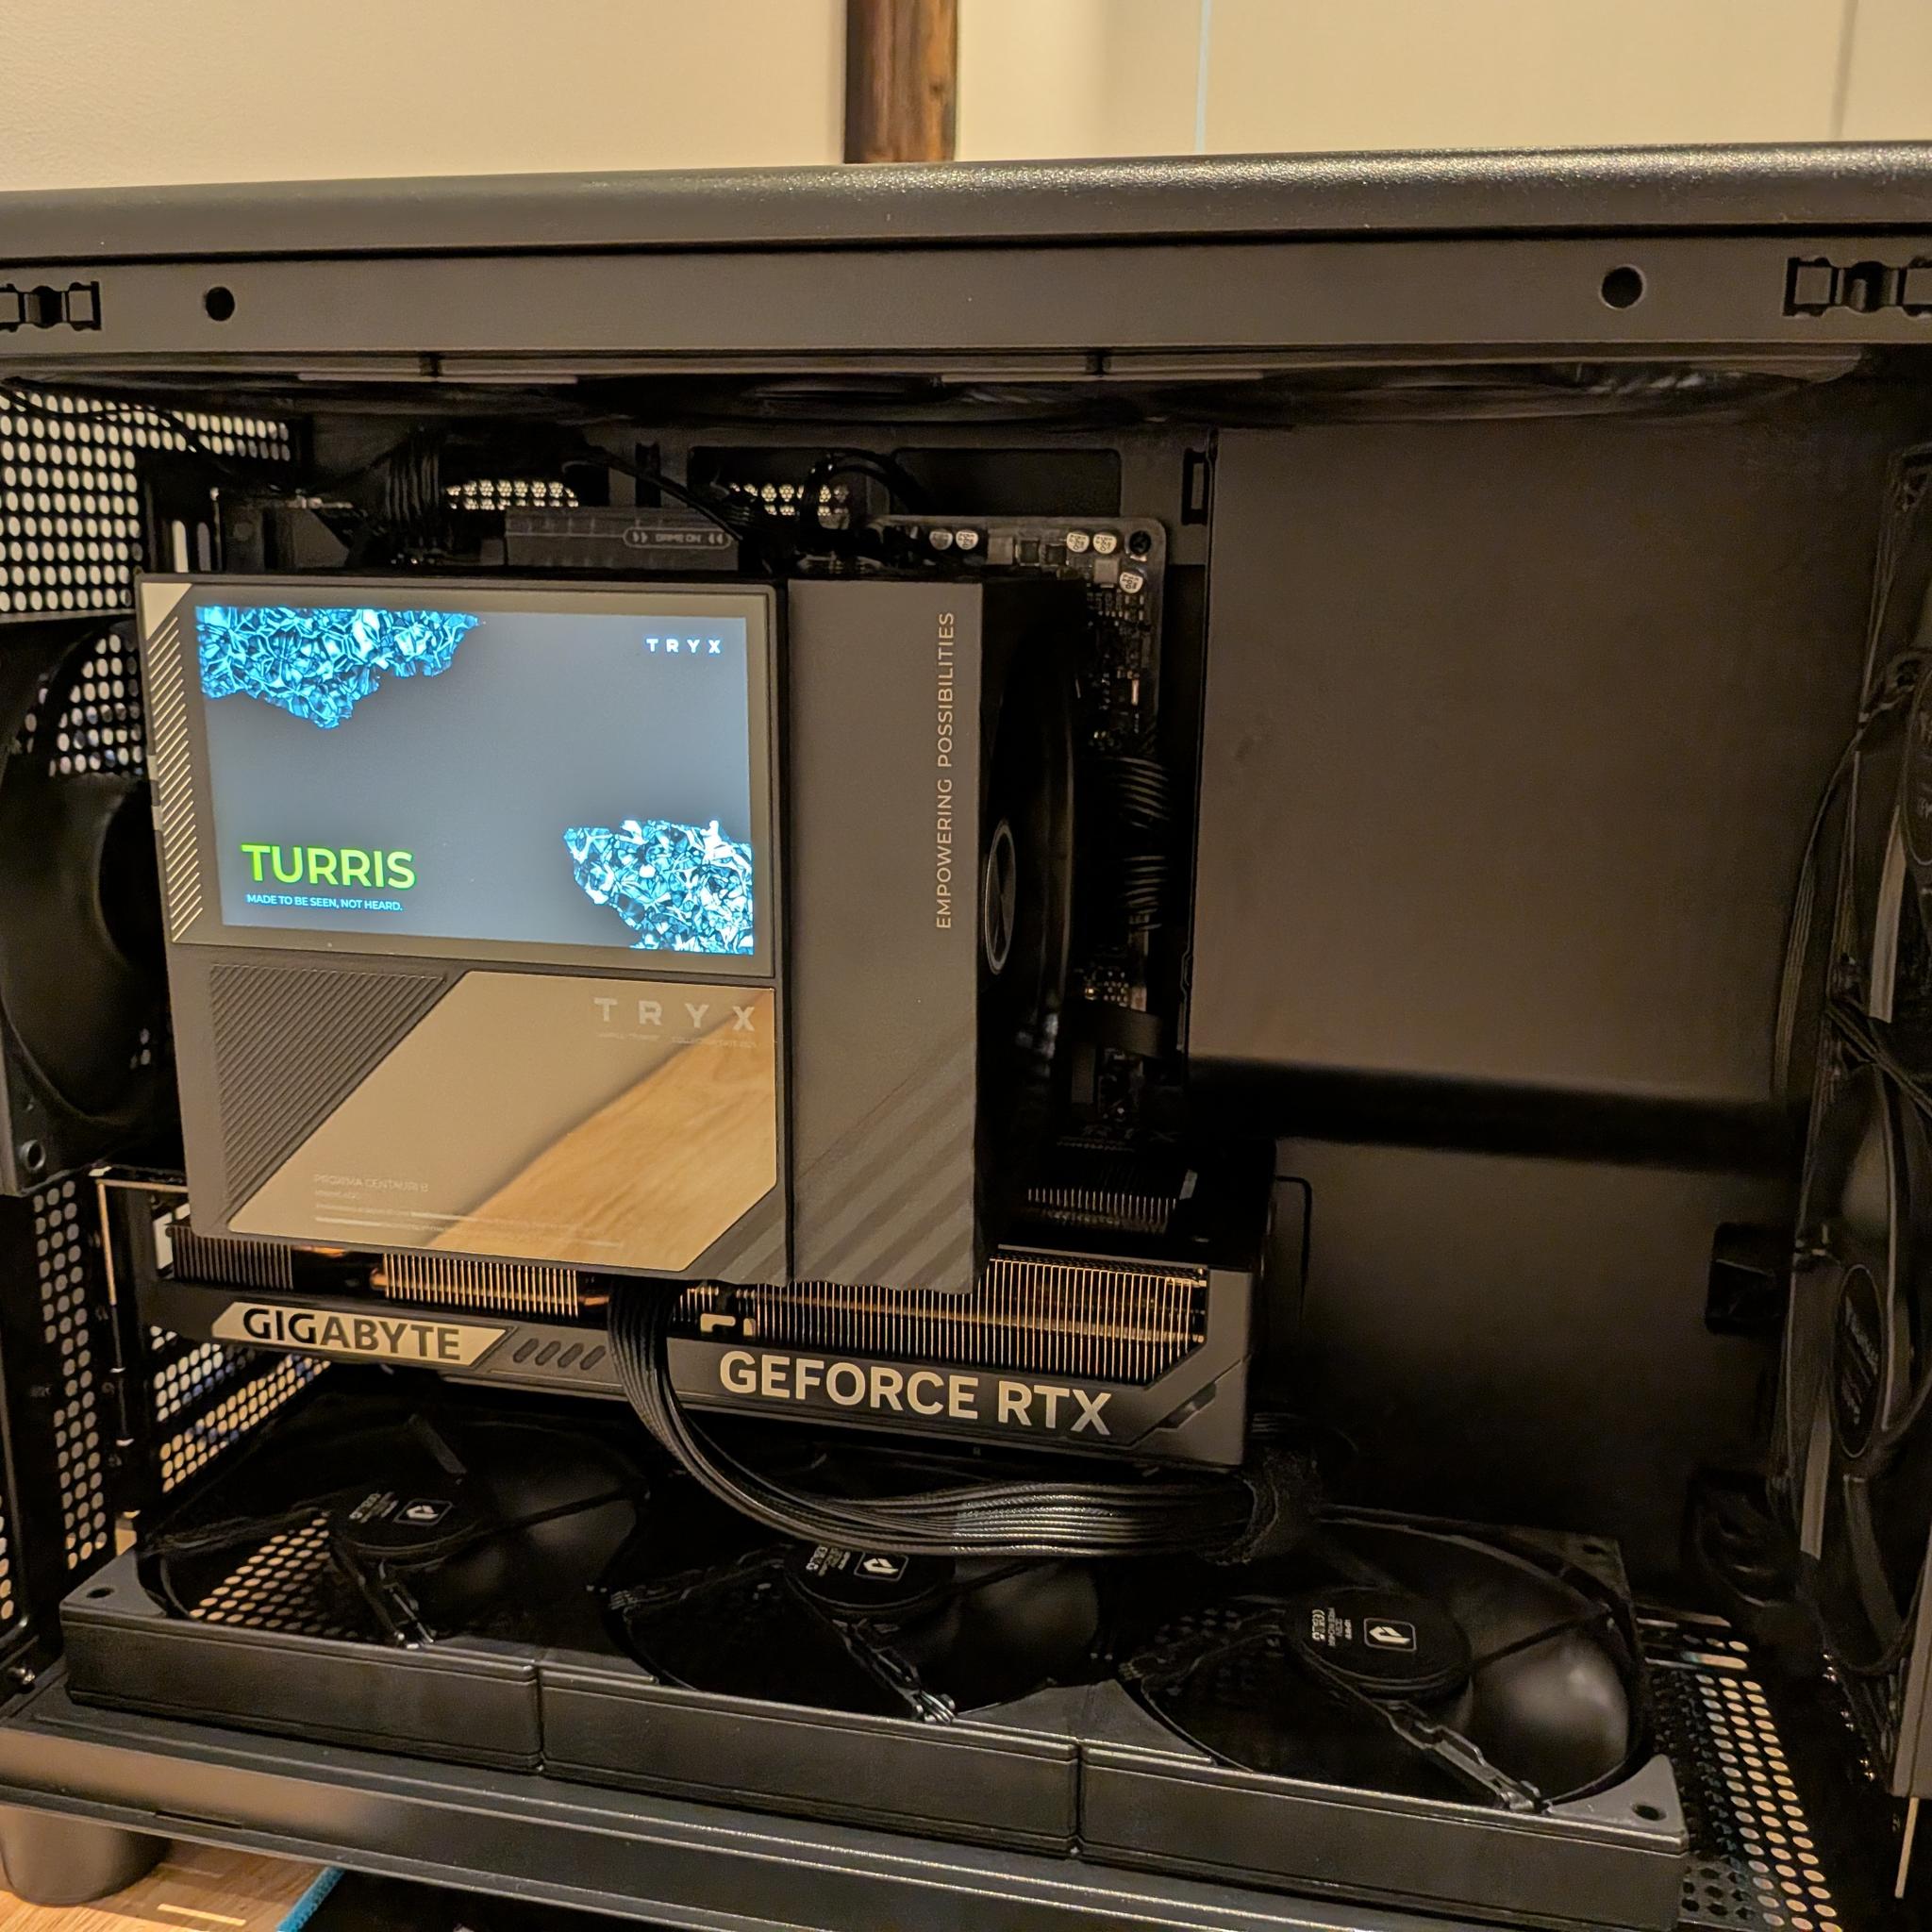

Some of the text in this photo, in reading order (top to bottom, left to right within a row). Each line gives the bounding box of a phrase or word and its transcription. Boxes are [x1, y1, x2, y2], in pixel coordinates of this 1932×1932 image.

[645, 638, 722, 654] TRYX
[936, 612, 955, 929] EMPOWERING POSSIBILITIES
[241, 843, 416, 889] TURRIS
[246, 894, 403, 911] MADE TO BE SEEN, NOT HEARD.
[593, 996, 756, 1032] TRYX
[242, 1307, 460, 1361] GIGABYTE
[719, 1350, 1112, 1436] GEFORCE RTX
